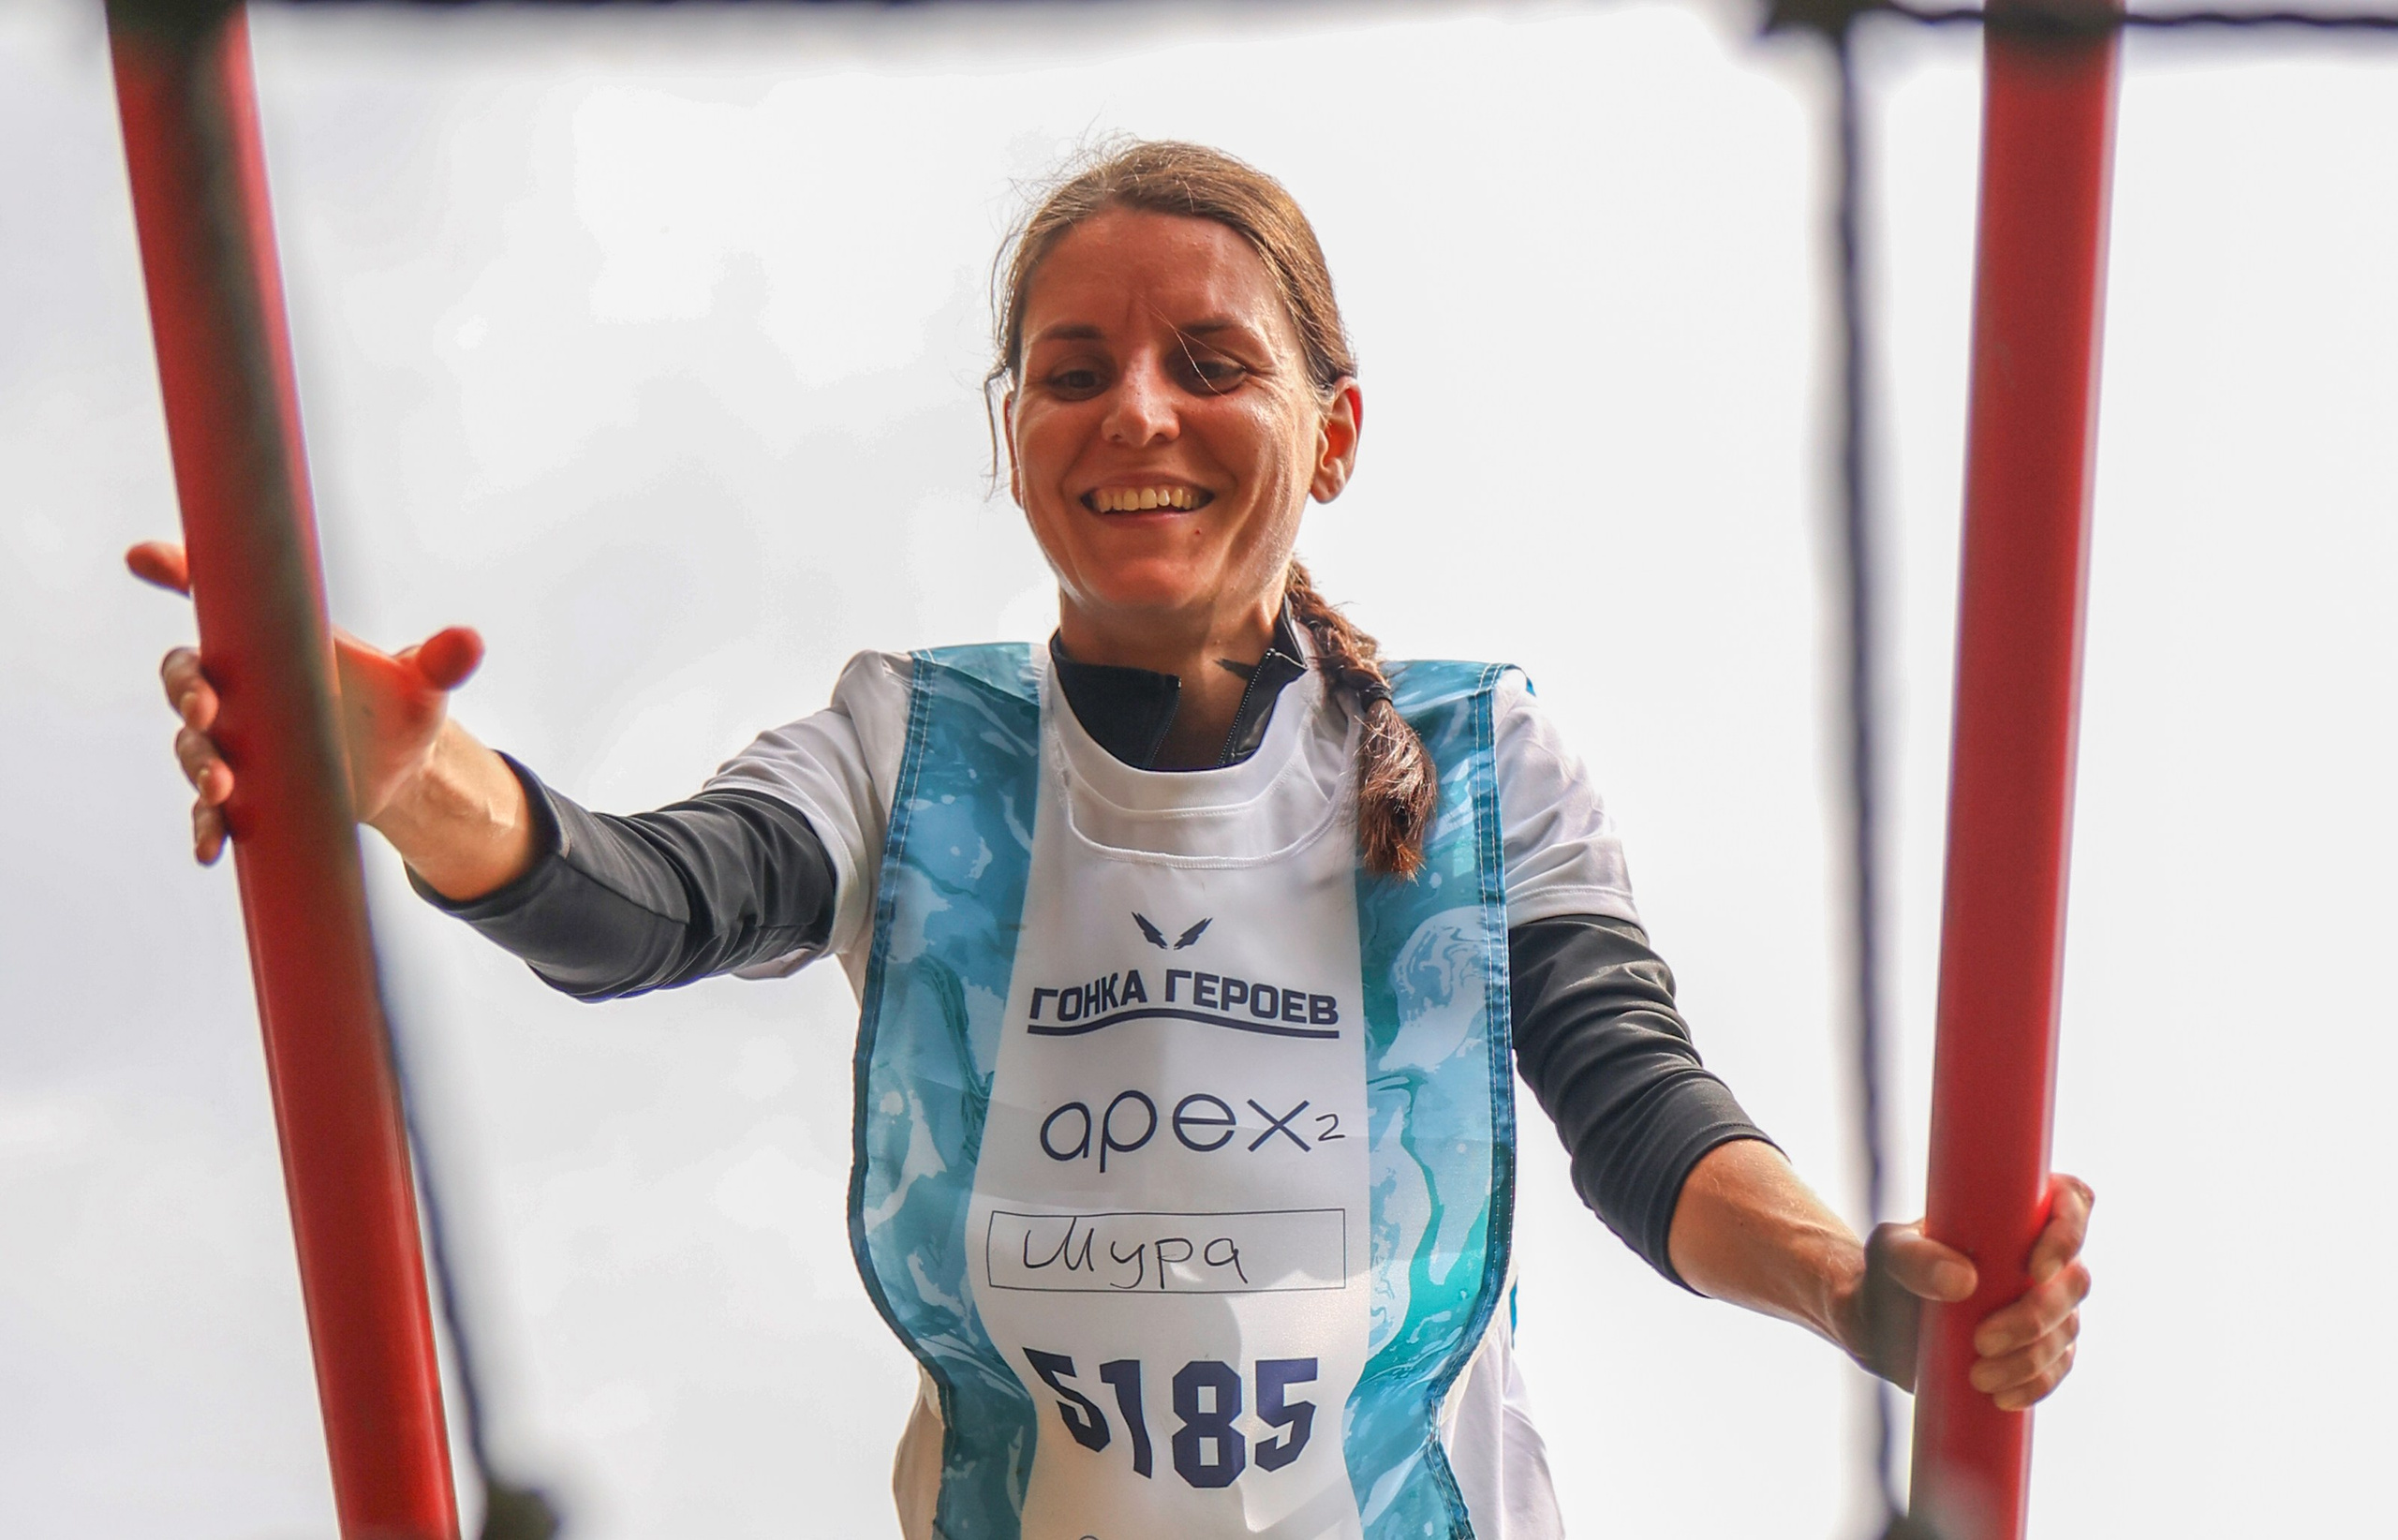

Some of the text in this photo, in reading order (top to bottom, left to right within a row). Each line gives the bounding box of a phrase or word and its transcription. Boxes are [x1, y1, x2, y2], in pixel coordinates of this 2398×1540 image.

[1029, 969, 1340, 1025] ГОНКА ГЕРОЕВ
[1040, 1089, 1311, 1174] apex
[1022, 1346, 1318, 1488] 5185
